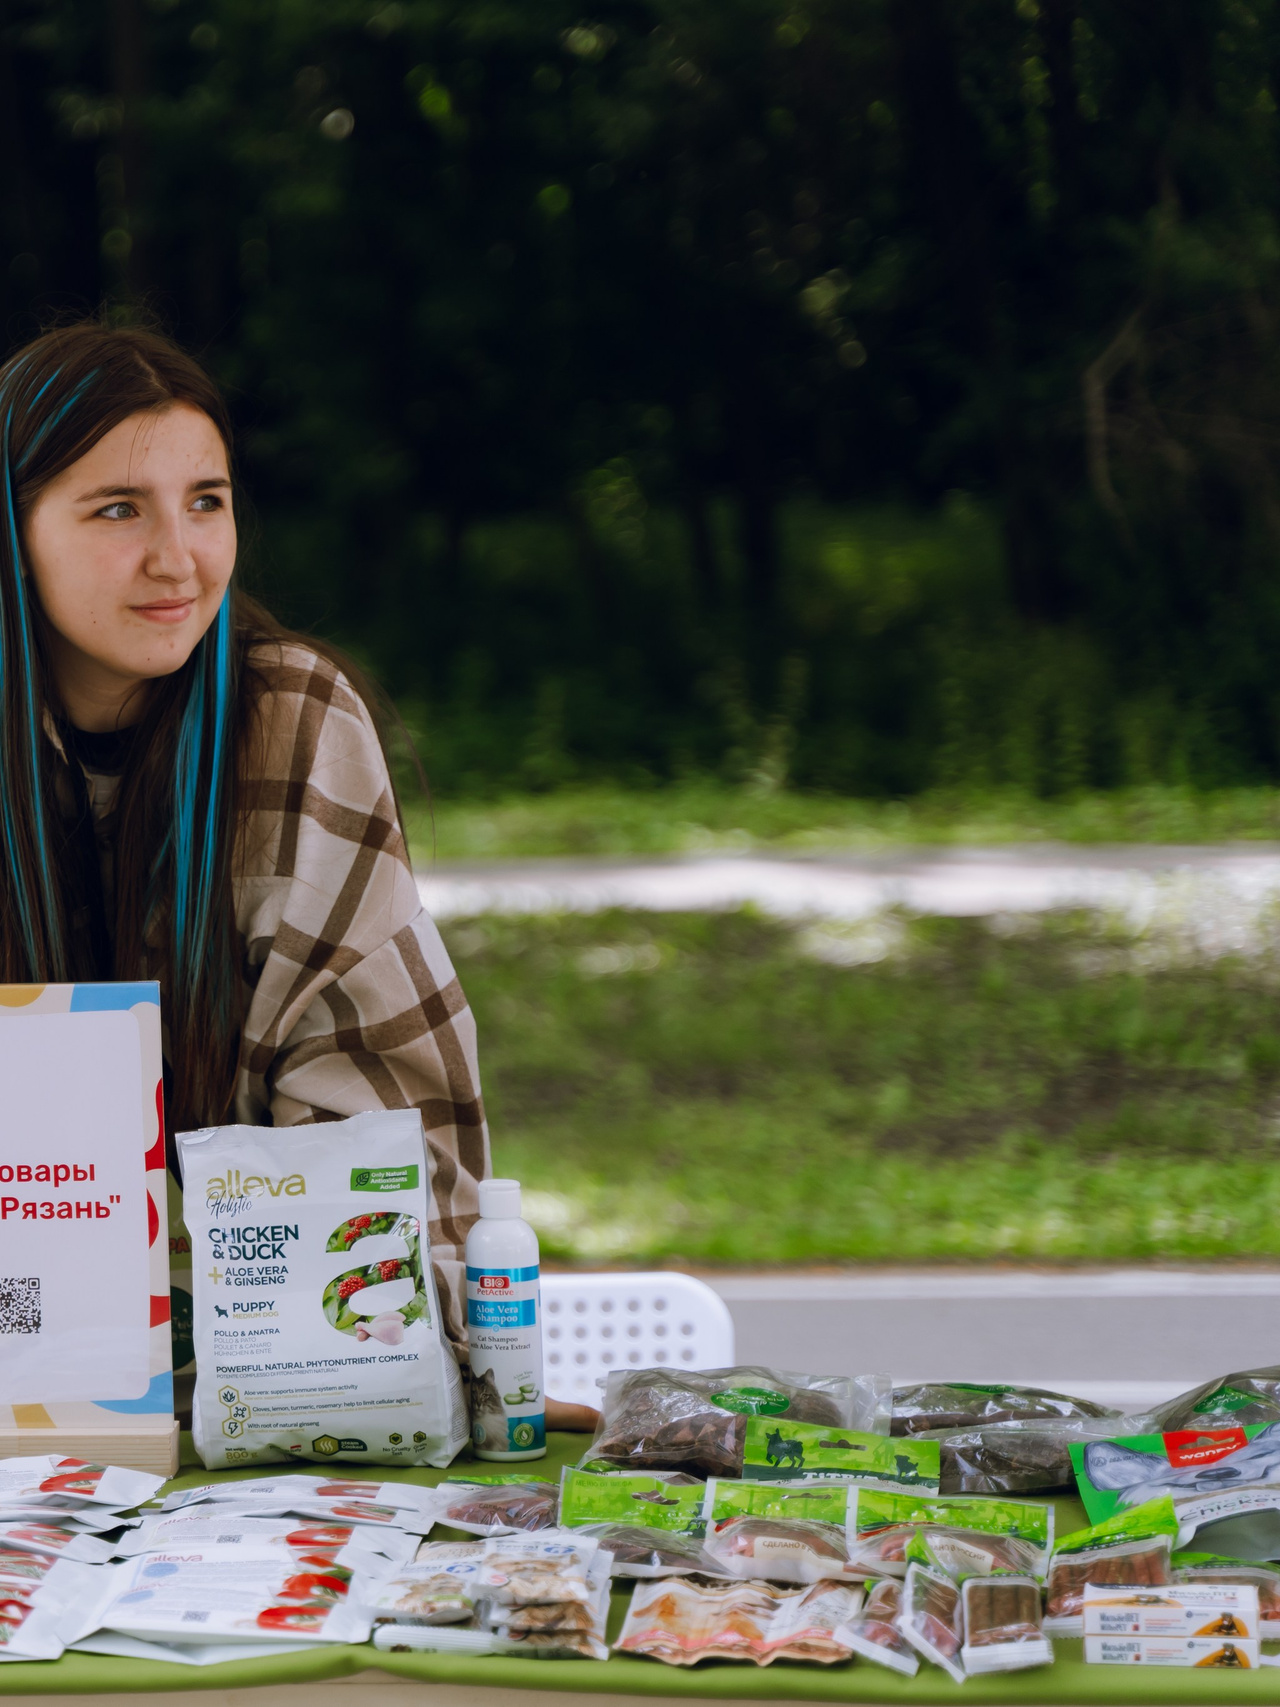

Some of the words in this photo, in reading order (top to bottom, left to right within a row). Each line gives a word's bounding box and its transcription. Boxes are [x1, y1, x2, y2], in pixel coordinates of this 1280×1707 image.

[371, 1171, 385, 1179] Only
[385, 1169, 408, 1177] Natural
[206, 1169, 306, 1199] alleva
[370, 1176, 408, 1184] Antioxidants
[1, 1195, 121, 1220] Рязань"
[206, 1191, 253, 1220] Holistic
[208, 1224, 299, 1244] CHICKEN
[212, 1244, 225, 1260] &
[229, 1242, 287, 1260] DUCK
[225, 1266, 254, 1276] ALOE
[256, 1265, 289, 1275] VERA
[225, 1277, 232, 1286] &
[234, 1275, 286, 1286] GINSENG
[477, 1287, 514, 1296] PetActive
[232, 1301, 275, 1314] PUPPY
[476, 1305, 495, 1313] Aloe
[497, 1304, 519, 1313] Vera
[233, 1312, 261, 1320] MEDIUM
[262, 1310, 279, 1319] DOG
[476, 1313, 519, 1325] Shampoo
[248, 1328, 281, 1336] ANATRA
[216, 1363, 263, 1373] POWERFUL
[265, 1361, 305, 1370] NATURAL
[307, 1357, 376, 1367] PHYTONUTRIENT
[378, 1353, 419, 1363] COMPLEX
[299, 1421, 320, 1429] ginseng
[226, 1452, 249, 1460] 800
[1180, 1443, 1238, 1460] wanpy
[762, 1540, 800, 1550] СДЕЛАНО
[145, 1554, 203, 1564] alleva
